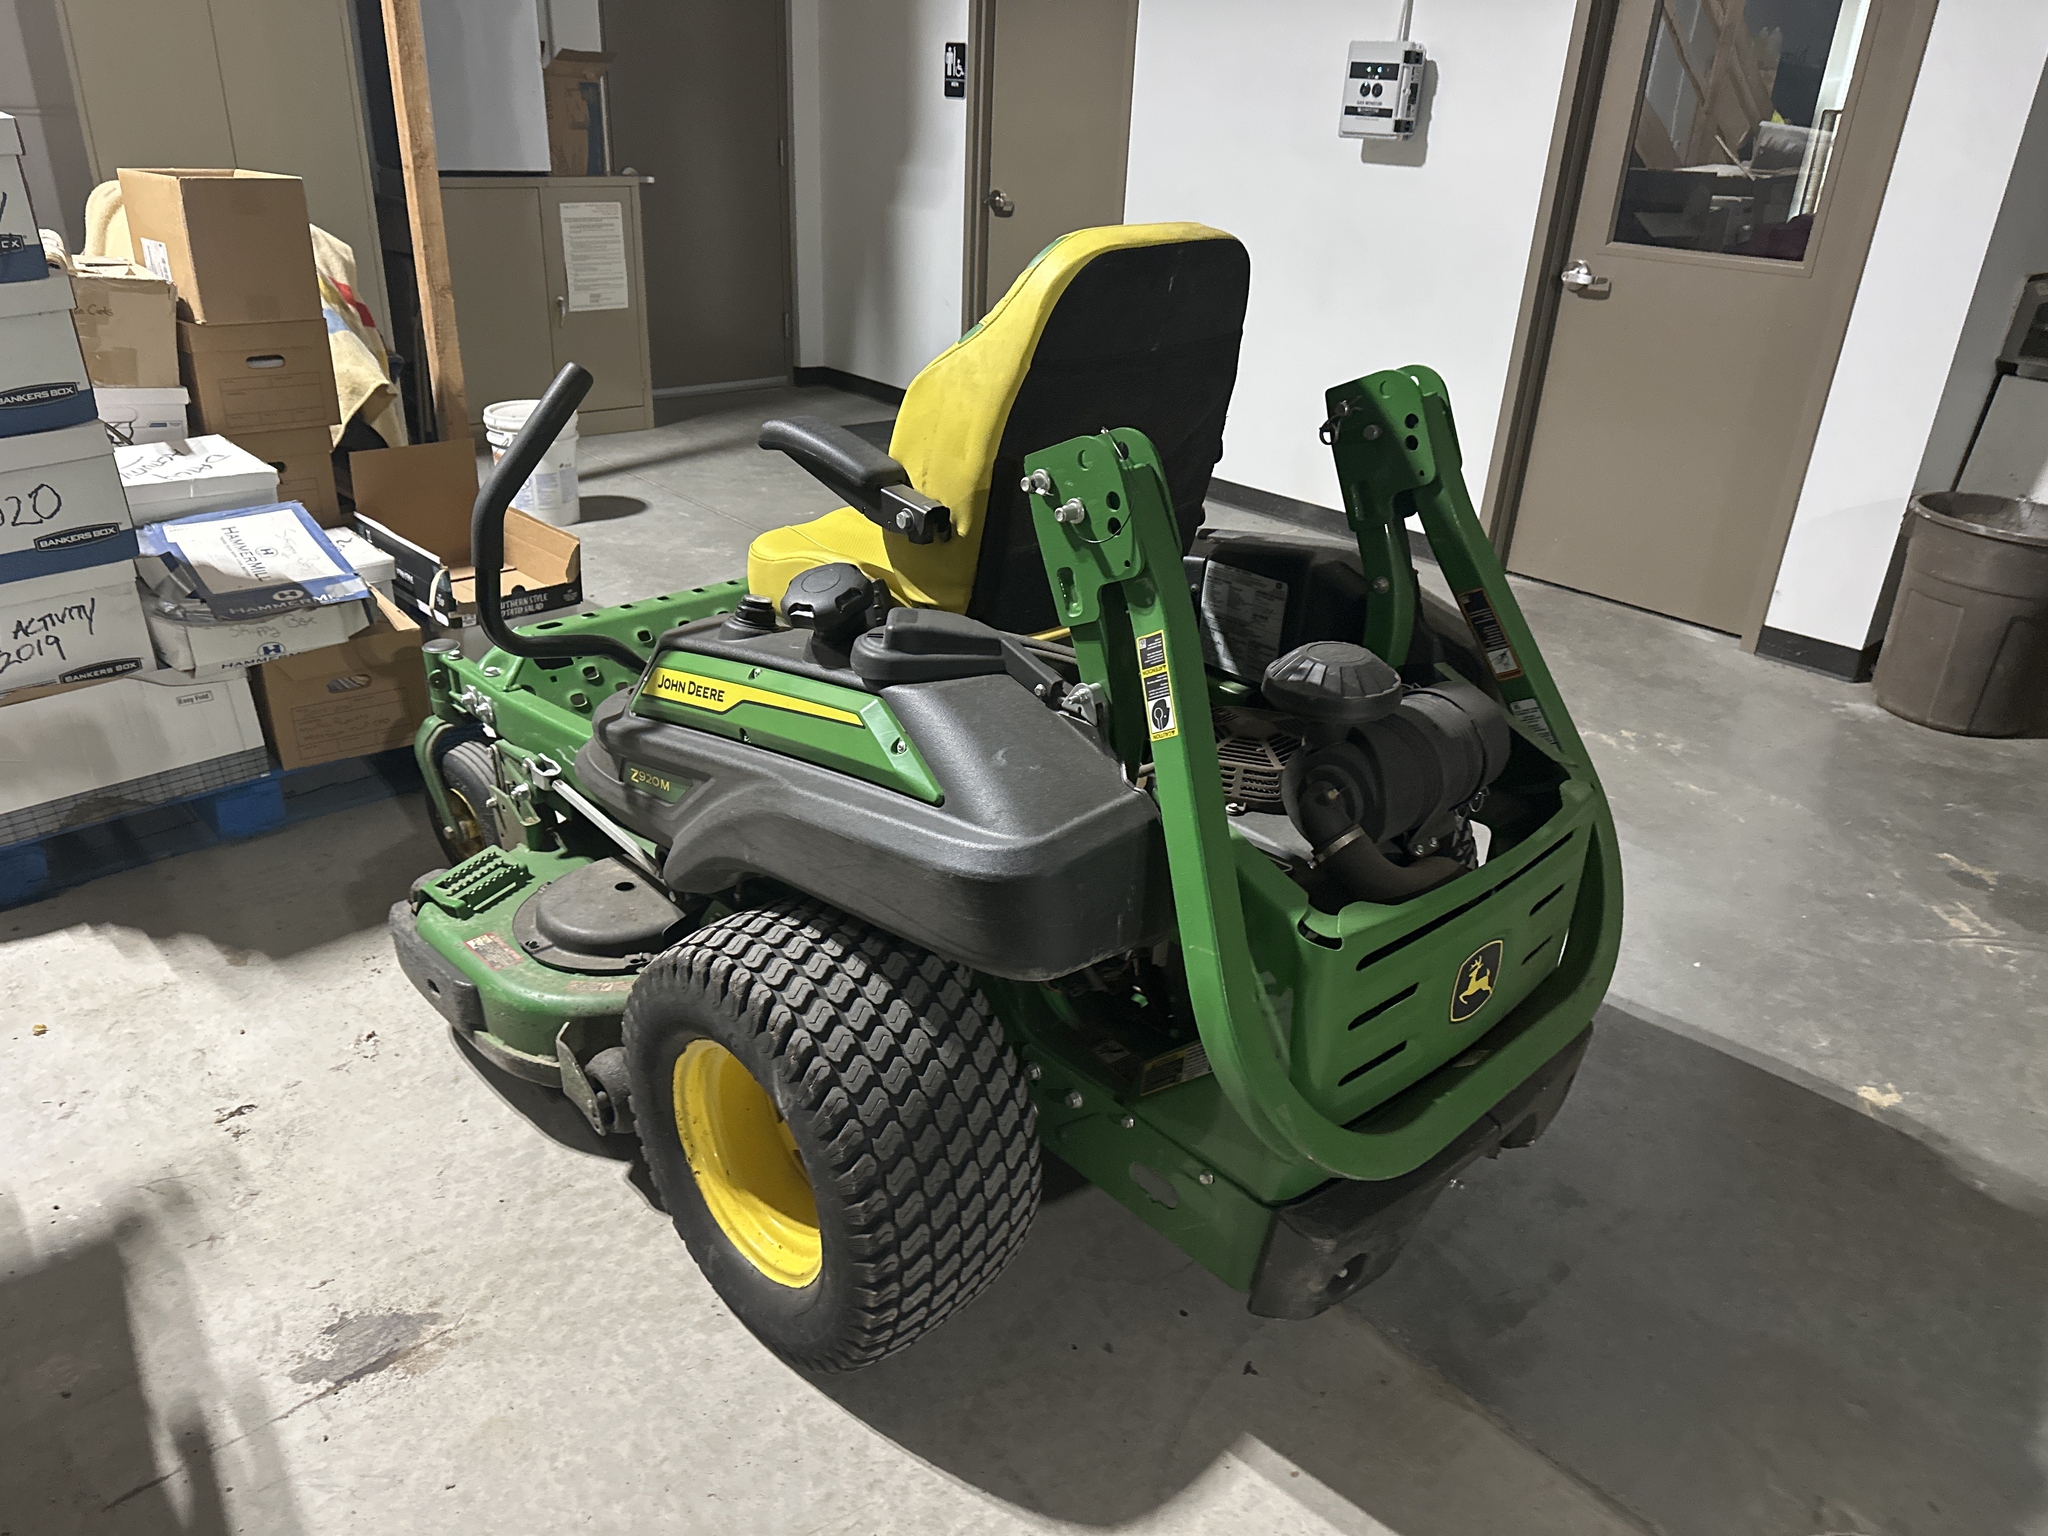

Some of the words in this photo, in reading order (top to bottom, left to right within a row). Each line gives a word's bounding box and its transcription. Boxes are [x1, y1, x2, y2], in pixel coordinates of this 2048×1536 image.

[50, 386, 74, 397] BOX
[39, 531, 92, 549] BANKERS
[93, 526, 117, 538] BOX
[501, 596, 528, 609] UTHERN
[529, 593, 548, 603] STYLE
[12, 597, 96, 640] ACTIVITY
[63, 666, 115, 683] BANKERS
[115, 660, 138, 673] BOX
[178, 695, 194, 706] Easy
[194, 692, 210, 702] Fold
[657, 674, 686, 694] JOHN
[687, 680, 725, 703] DEERE
[630, 767, 671, 792] Z920M
